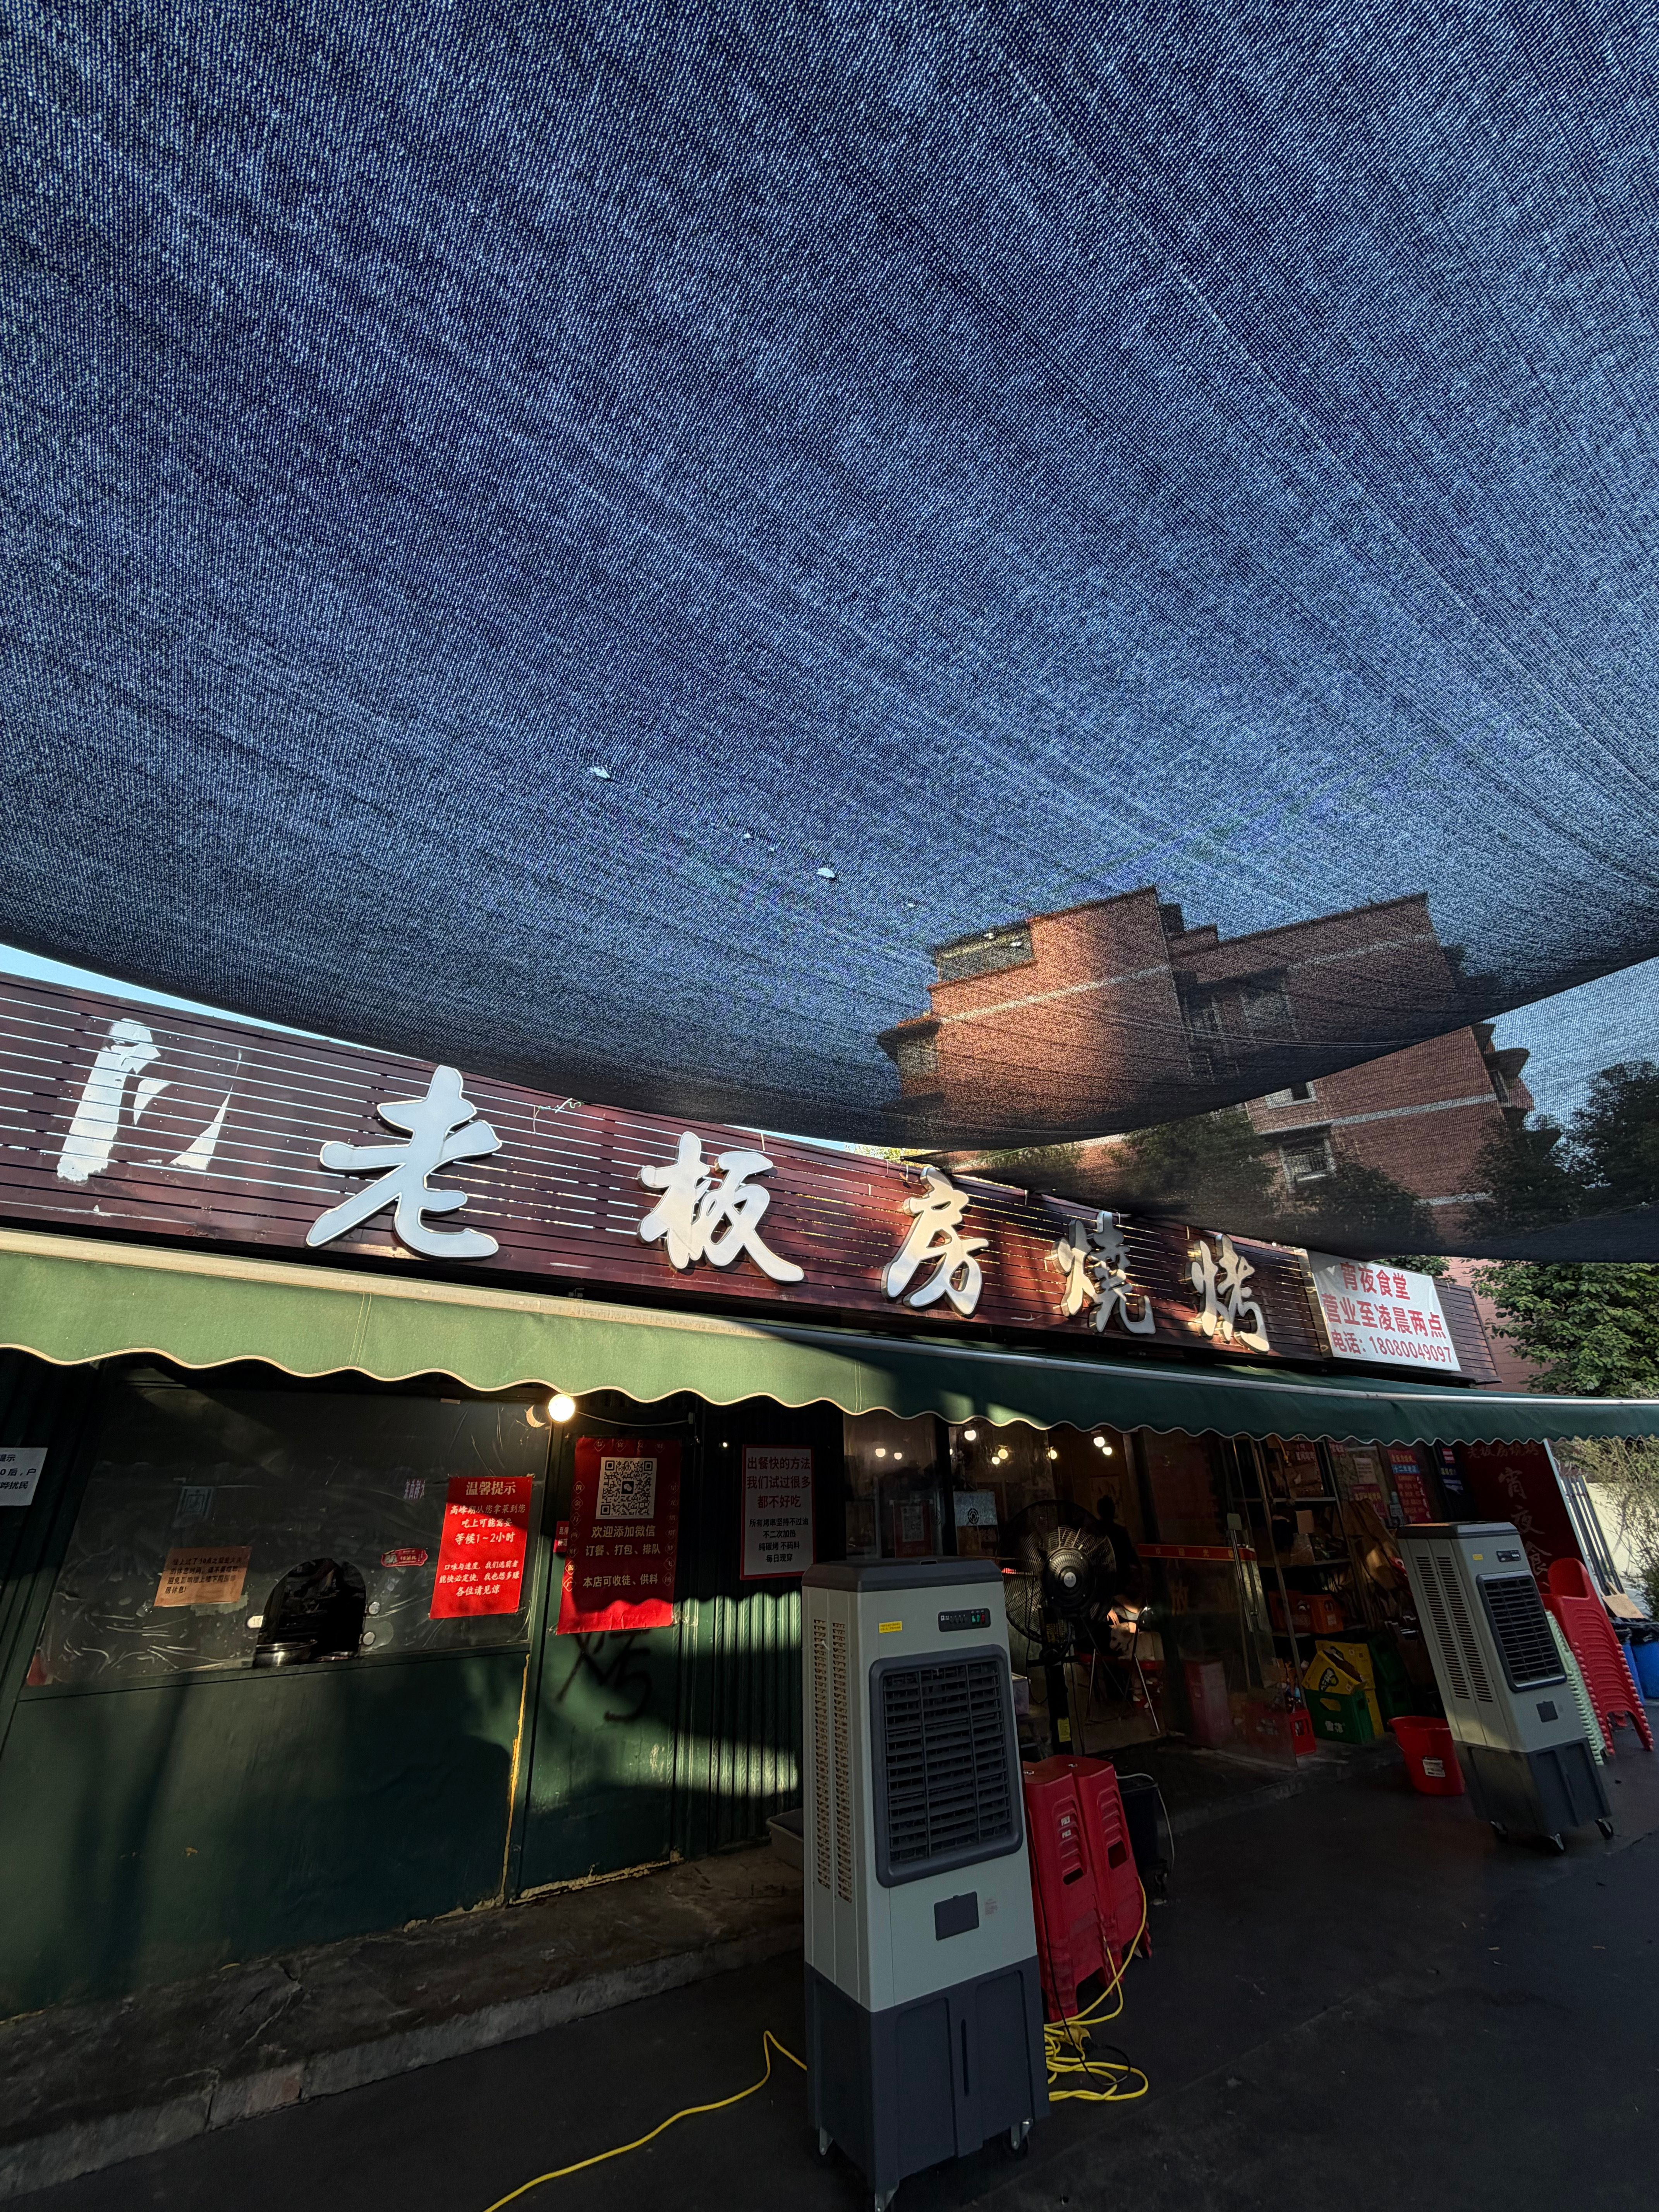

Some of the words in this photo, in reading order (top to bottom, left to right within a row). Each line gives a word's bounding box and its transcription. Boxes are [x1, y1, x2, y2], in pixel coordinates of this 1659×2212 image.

[1340, 1261, 1411, 1300] 宵夜食堂
[1321, 1292, 1447, 1339] 营业至凌晨两点
[747, 1456, 810, 1470] 出餐快的方法
[466, 1481, 516, 1495] 温馨提示
[747, 1476, 811, 1489] 我们试过很多
[757, 1495, 801, 1508] 都不好吃
[450, 1504, 526, 1515] 高峰期从您拿菜到您
[461, 1518, 512, 1528] 吃上可能需要
[749, 1518, 808, 1527] 所有烤串坚持不过油
[1498, 1466, 1553, 1586] 宵夜食
[591, 1525, 656, 1538] 欢迎添加微信
[763, 1530, 796, 1538] 不二次加热
[585, 1543, 661, 1556] 订餐、打包、排队
[766, 1553, 793, 1563] 每日现穿
[582, 1573, 658, 1588] 本店可收徒、供料
[455, 1584, 501, 1597] 各位请见谅
